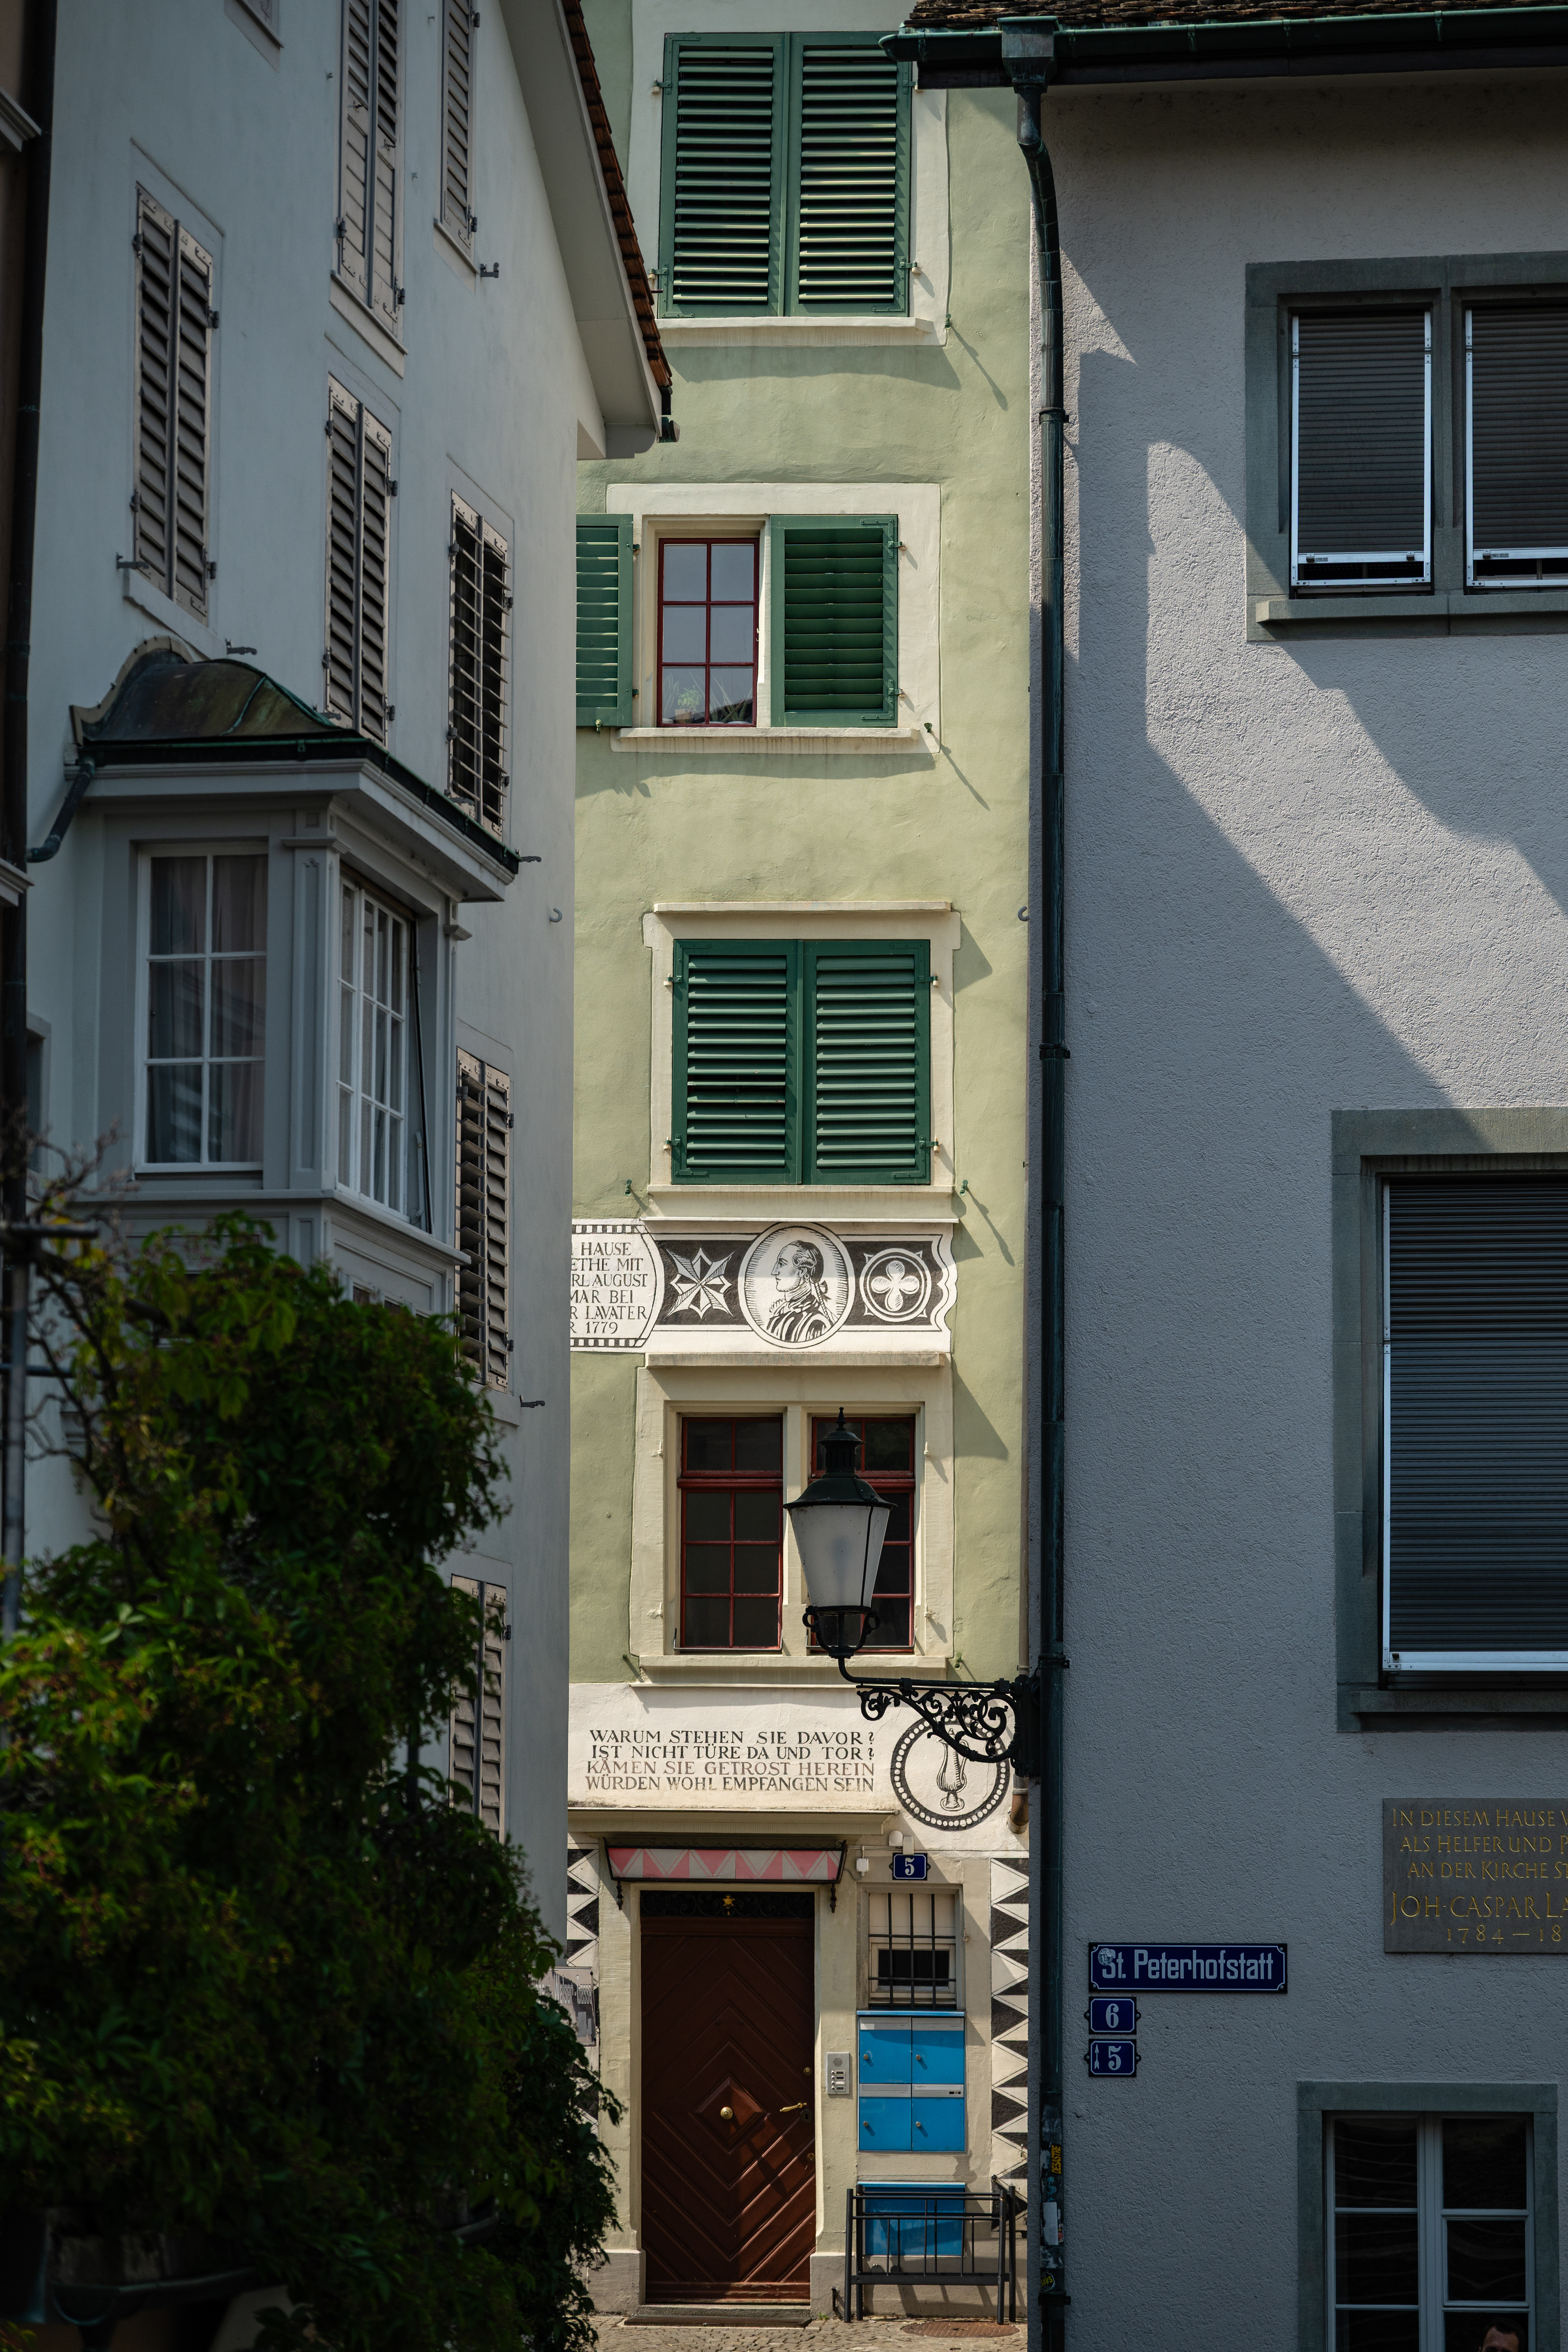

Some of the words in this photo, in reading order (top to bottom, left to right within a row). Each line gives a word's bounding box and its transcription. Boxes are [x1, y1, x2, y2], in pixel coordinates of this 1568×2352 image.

[581, 1243, 631, 1256] HAUSE
[617, 1258, 643, 1271] MIT
[592, 1274, 648, 1287] AUGUST
[610, 1290, 633, 1303] BEI
[585, 1306, 647, 1319] LAVATER
[586, 1322, 617, 1334] 1779
[590, 1730, 660, 1743] WARUM
[669, 1731, 743, 1743] STEHEN
[757, 1732, 786, 1744] SIE
[592, 1745, 622, 1759] IST
[632, 1746, 688, 1758] NICHT
[694, 1743, 740, 1759] TÜRE
[747, 1747, 769, 1759] DA
[777, 1747, 811, 1760] UND
[588, 1758, 656, 1774] KÄMEN
[664, 1761, 695, 1774] SIE
[705, 1761, 790, 1775] GETROST
[799, 1762, 873, 1775] HEREIN
[585, 1774, 660, 1790] WÜRDEN
[666, 1777, 717, 1790] WOHL
[723, 1777, 828, 1791] EMPFANGEN
[834, 1778, 873, 1791] SEIN
[1393, 1809, 1412, 1826] IN
[1421, 1811, 1489, 1826] DIESEM
[1497, 1810, 1555, 1826] HAUSE
[1400, 1837, 1430, 1851] ALS
[1439, 1835, 1504, 1852] HELFER
[1509, 1837, 1552, 1852] UND
[905, 1858, 914, 1875] 5
[1408, 1862, 1433, 1877] AN
[1441, 1862, 1476, 1878] DER
[1482, 1861, 1548, 1881] KIRCHE
[1451, 1897, 1540, 1919] CASPAR
[1448, 1925, 1504, 1944] 1784
[1101, 1948, 1126, 1978] St.
[1135, 1949, 1273, 1979] Peterhofstatt
[1106, 2004, 1118, 2028] 6
[1109, 2046, 1121, 2070] 5
[1051, 2145, 1061, 2174] DESASTRE
